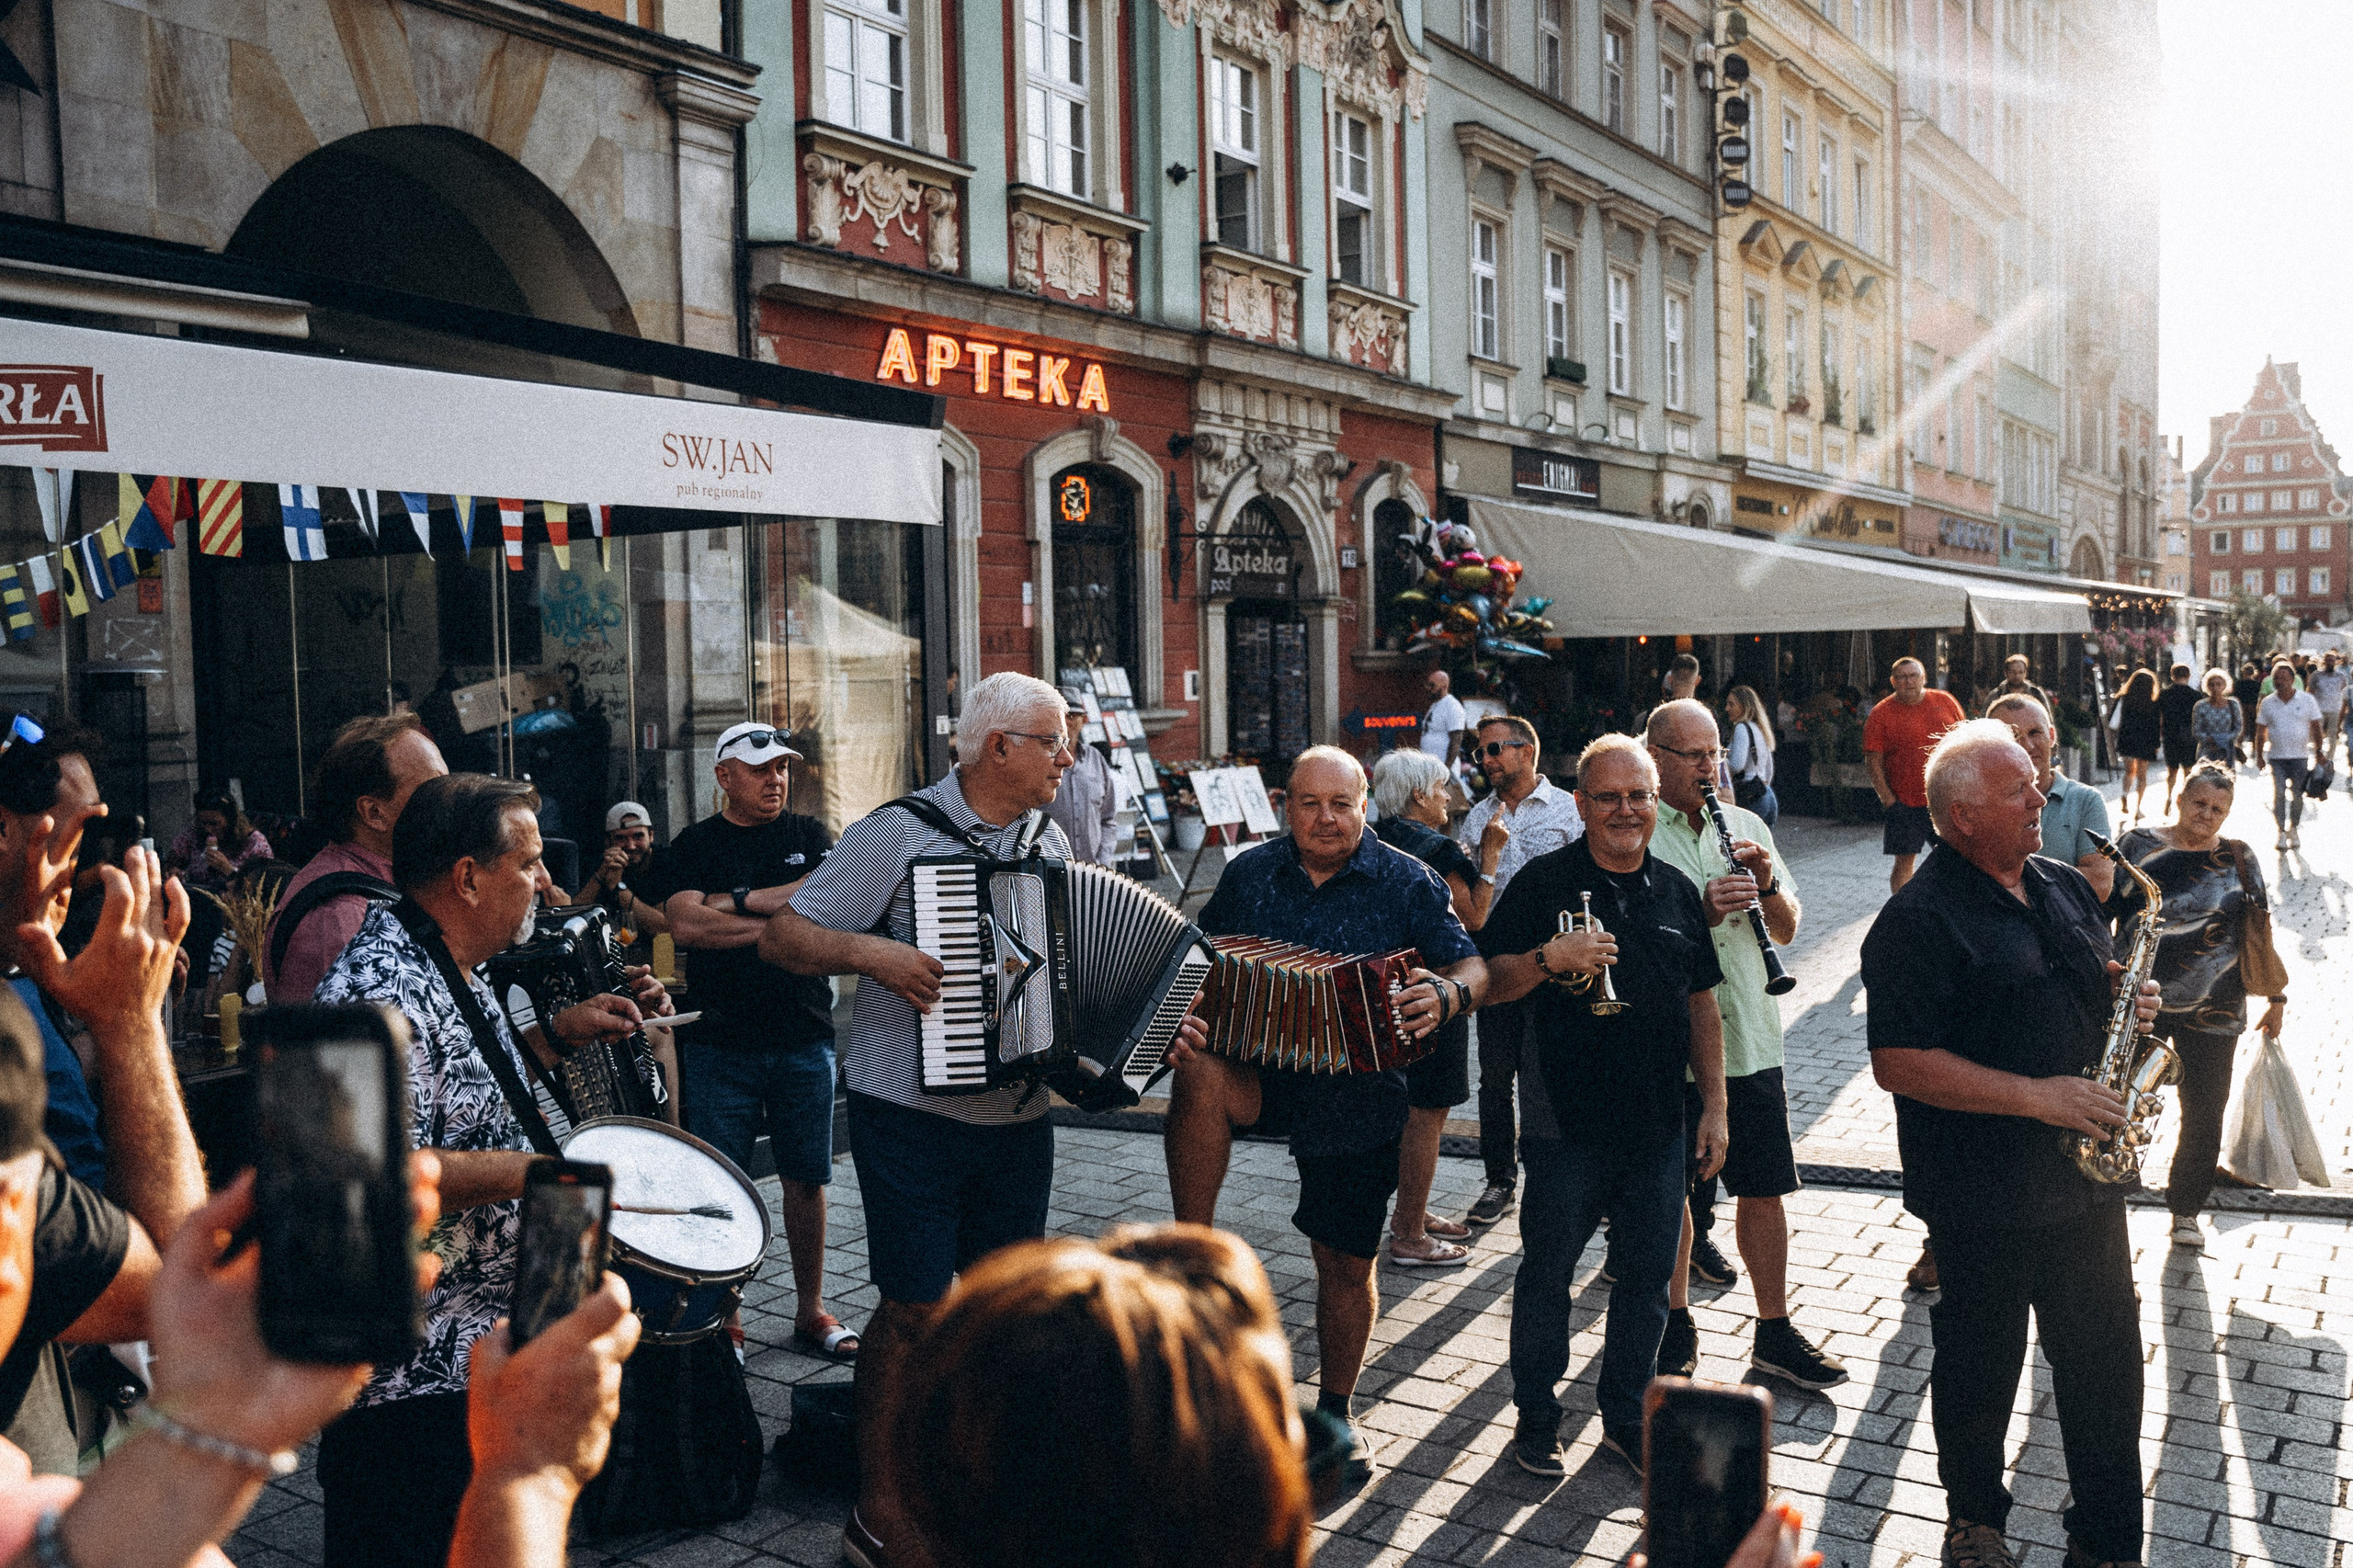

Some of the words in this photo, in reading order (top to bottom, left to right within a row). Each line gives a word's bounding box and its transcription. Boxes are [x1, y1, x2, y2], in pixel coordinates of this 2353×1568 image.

[876, 328, 1109, 413] APTEKA
[676, 482, 699, 497] pub
[702, 484, 763, 503] regionalny
[1213, 546, 1288, 576] Apteka
[1211, 577, 1232, 594] pod
[1055, 932, 1067, 989] BELLINI
